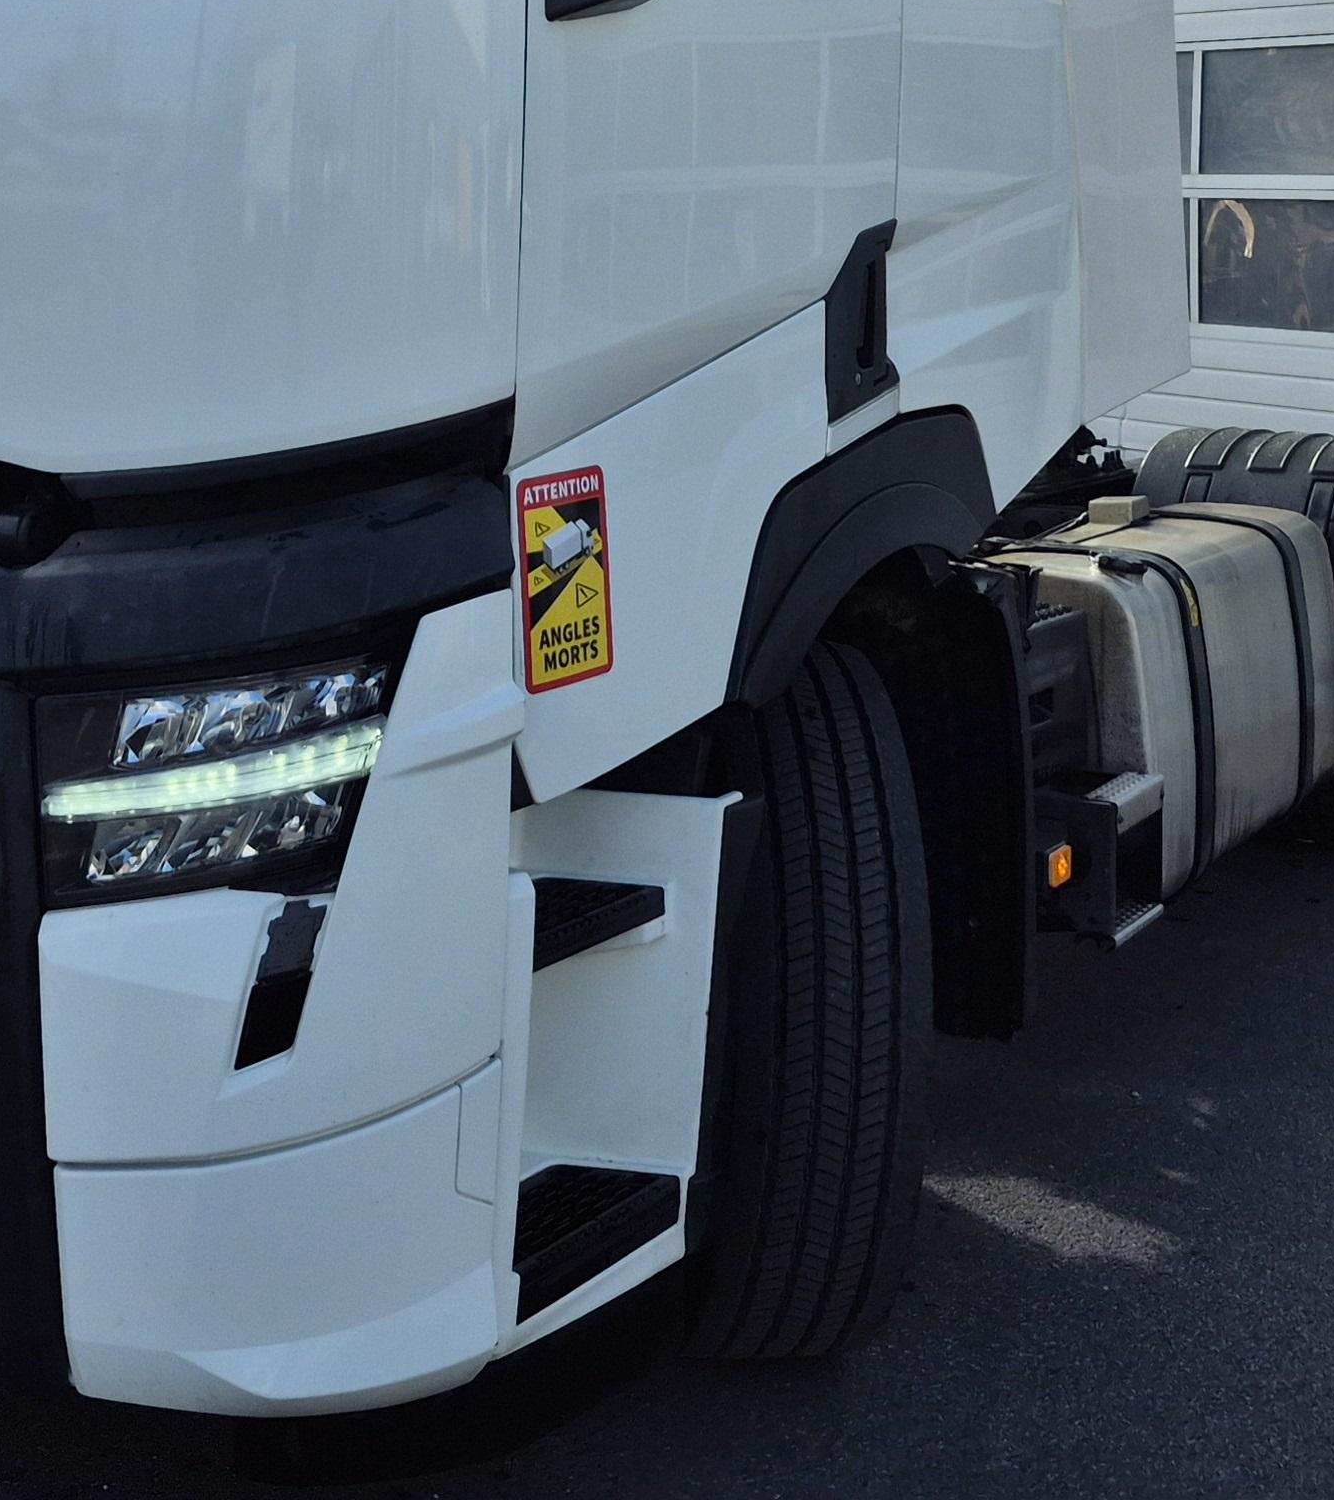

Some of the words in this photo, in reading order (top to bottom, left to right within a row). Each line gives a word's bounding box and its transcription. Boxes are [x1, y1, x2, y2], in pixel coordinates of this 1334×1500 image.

[523, 474, 599, 506] ATTENTION
[538, 615, 600, 650] ANGLES
[543, 639, 599, 673] MORTS
